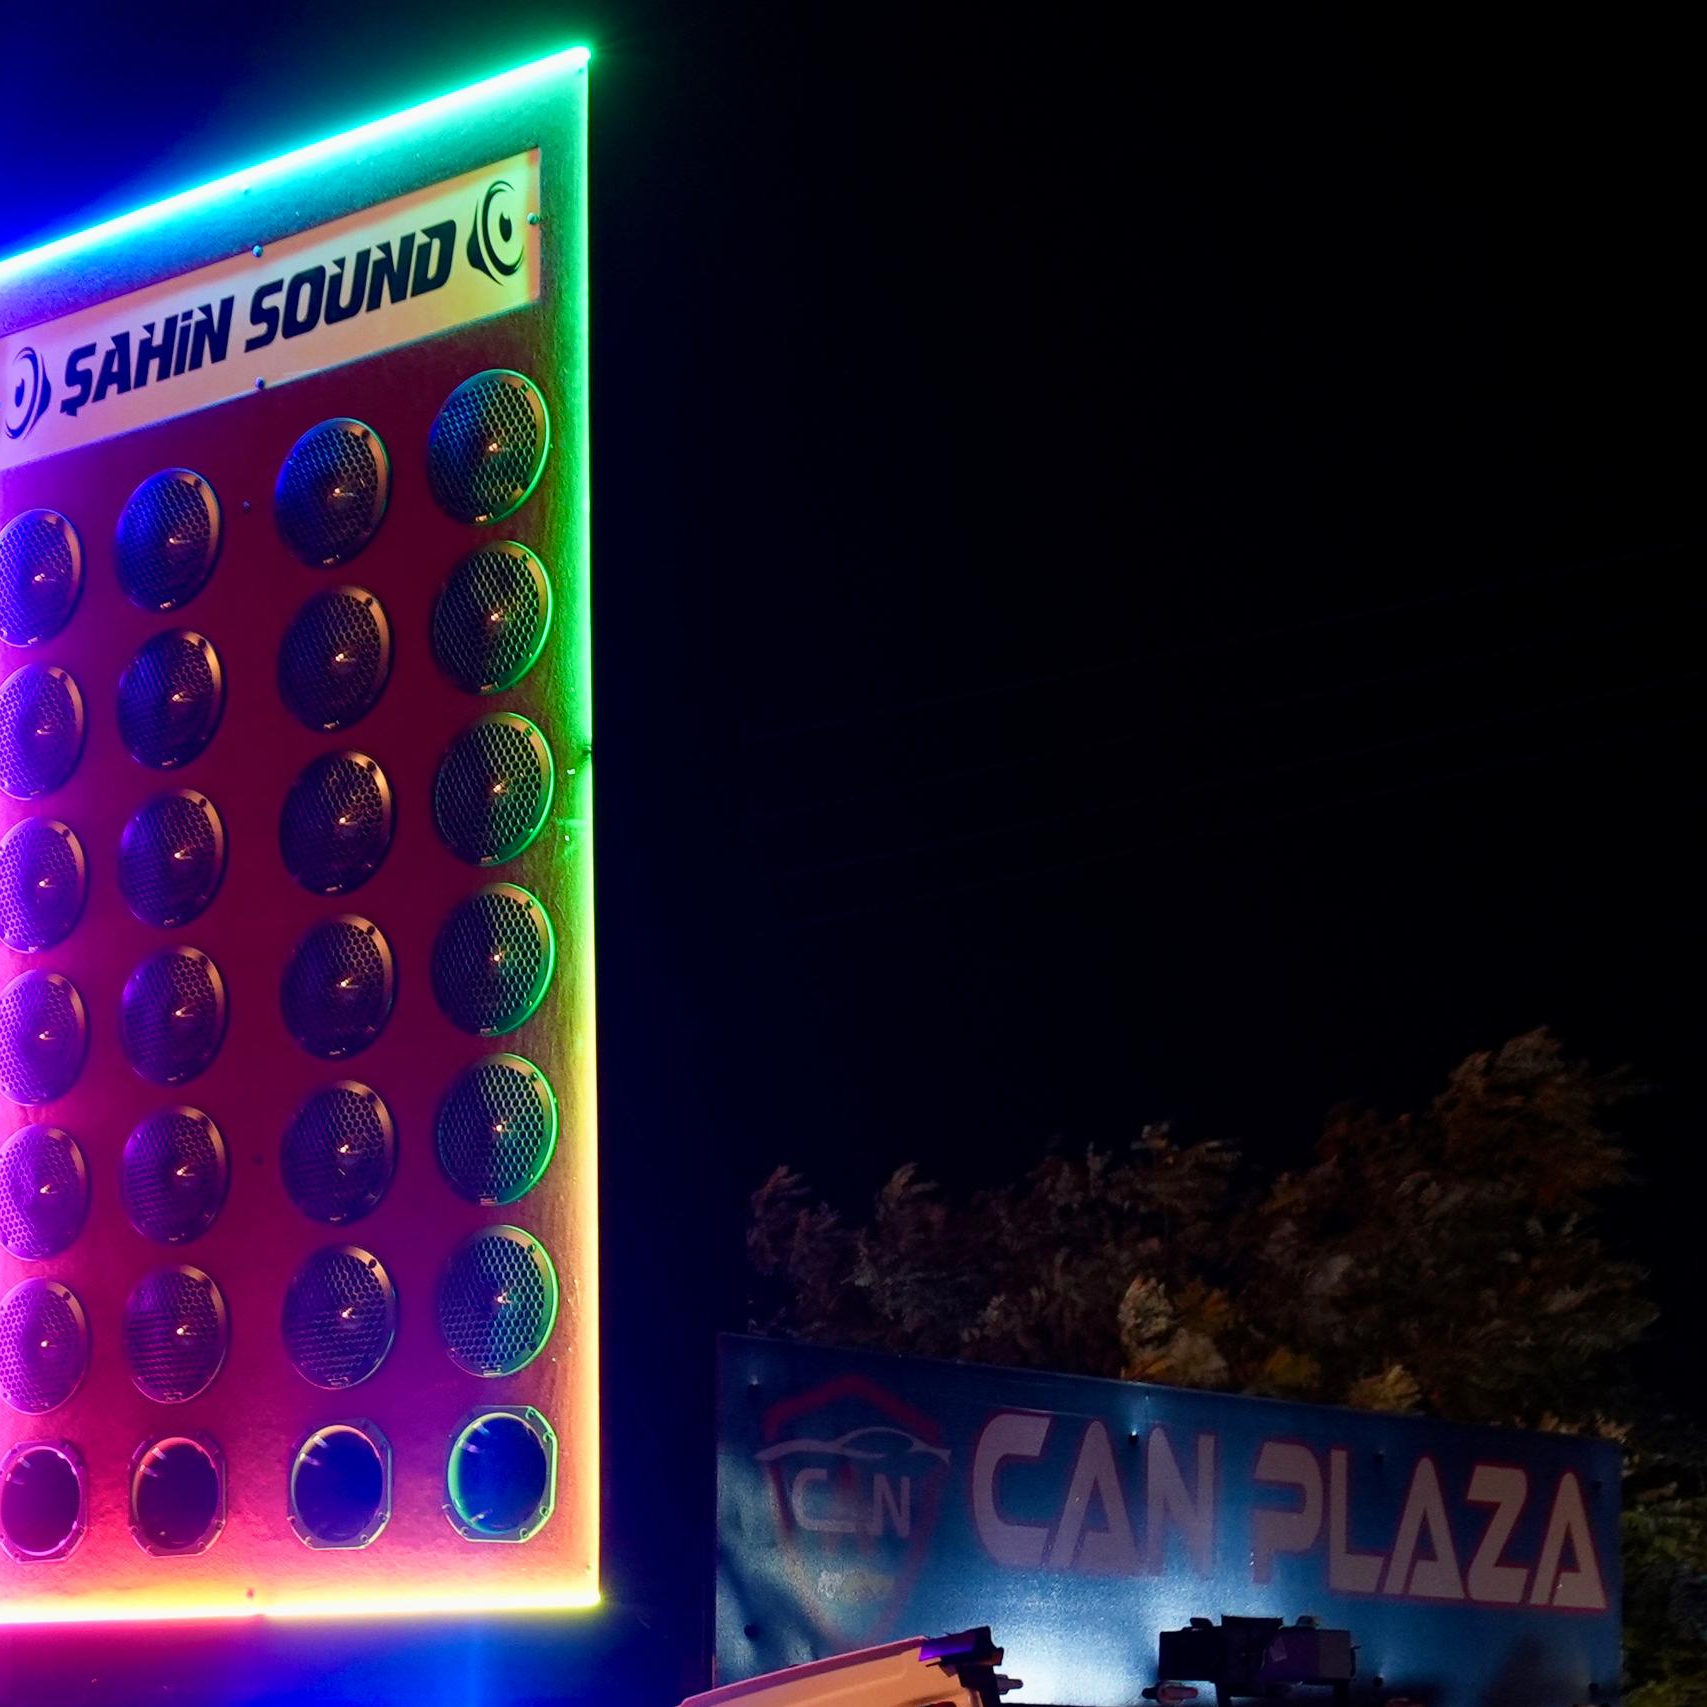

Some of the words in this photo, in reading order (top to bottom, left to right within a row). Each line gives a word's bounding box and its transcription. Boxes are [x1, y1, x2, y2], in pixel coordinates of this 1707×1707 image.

[246, 220, 456, 351] SOUND
[974, 1413, 1217, 1573] CAN
[1250, 1441, 1606, 1608] PLAZA
